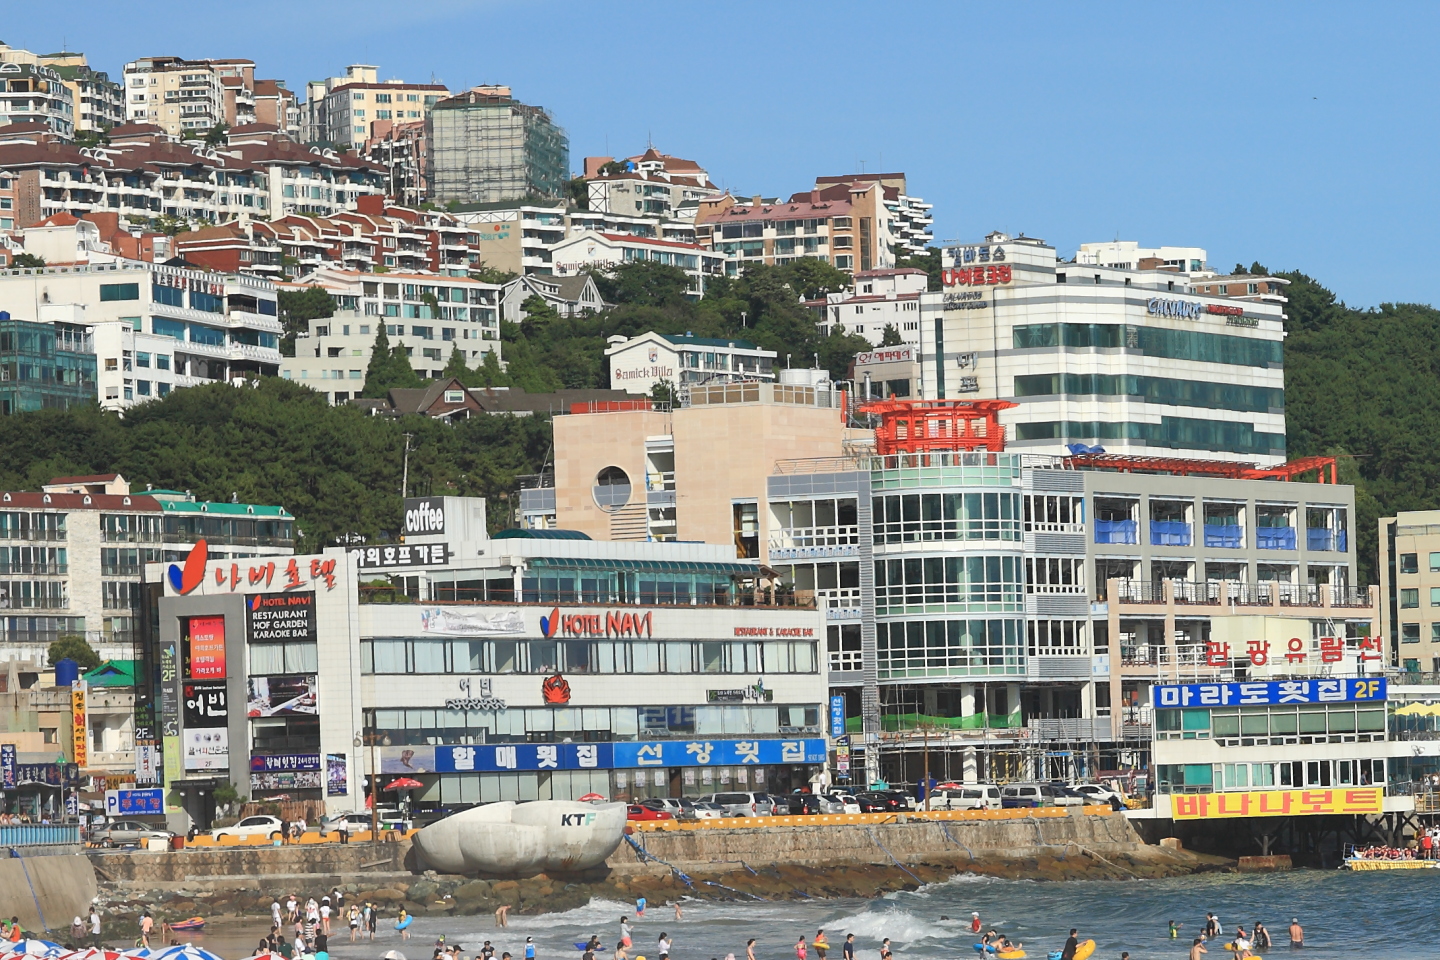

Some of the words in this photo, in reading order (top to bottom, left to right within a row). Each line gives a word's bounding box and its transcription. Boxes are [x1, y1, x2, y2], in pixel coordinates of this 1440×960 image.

[406, 502, 444, 532] coffee
[383, 546, 412, 565] 호프
[415, 545, 444, 564] 가든
[215, 558, 337, 592] 나비호텔
[262, 598, 287, 606] HOTEL
[287, 596, 311, 606] NAVI
[252, 609, 308, 620] RESTAURANT
[253, 620, 271, 629] HOF
[273, 619, 308, 629] GARDEN
[562, 613, 605, 635] HOTEL
[606, 609, 654, 638] NAVI
[253, 630, 292, 639] KARAOKE
[292, 629, 308, 638] BAR
[1206, 635, 1383, 668] 관광유람선
[162, 669, 177, 682] 2F
[186, 691, 228, 717] 어빈
[1160, 678, 1348, 708] 마라도횟집
[1354, 681, 1380, 699] 2F
[452, 744, 599, 771] 할매횟집
[636, 739, 807, 767] 선창횟집
[108, 796, 117, 813] P
[1176, 788, 1379, 817] 바나나보트
[561, 812, 597, 827] KTF
